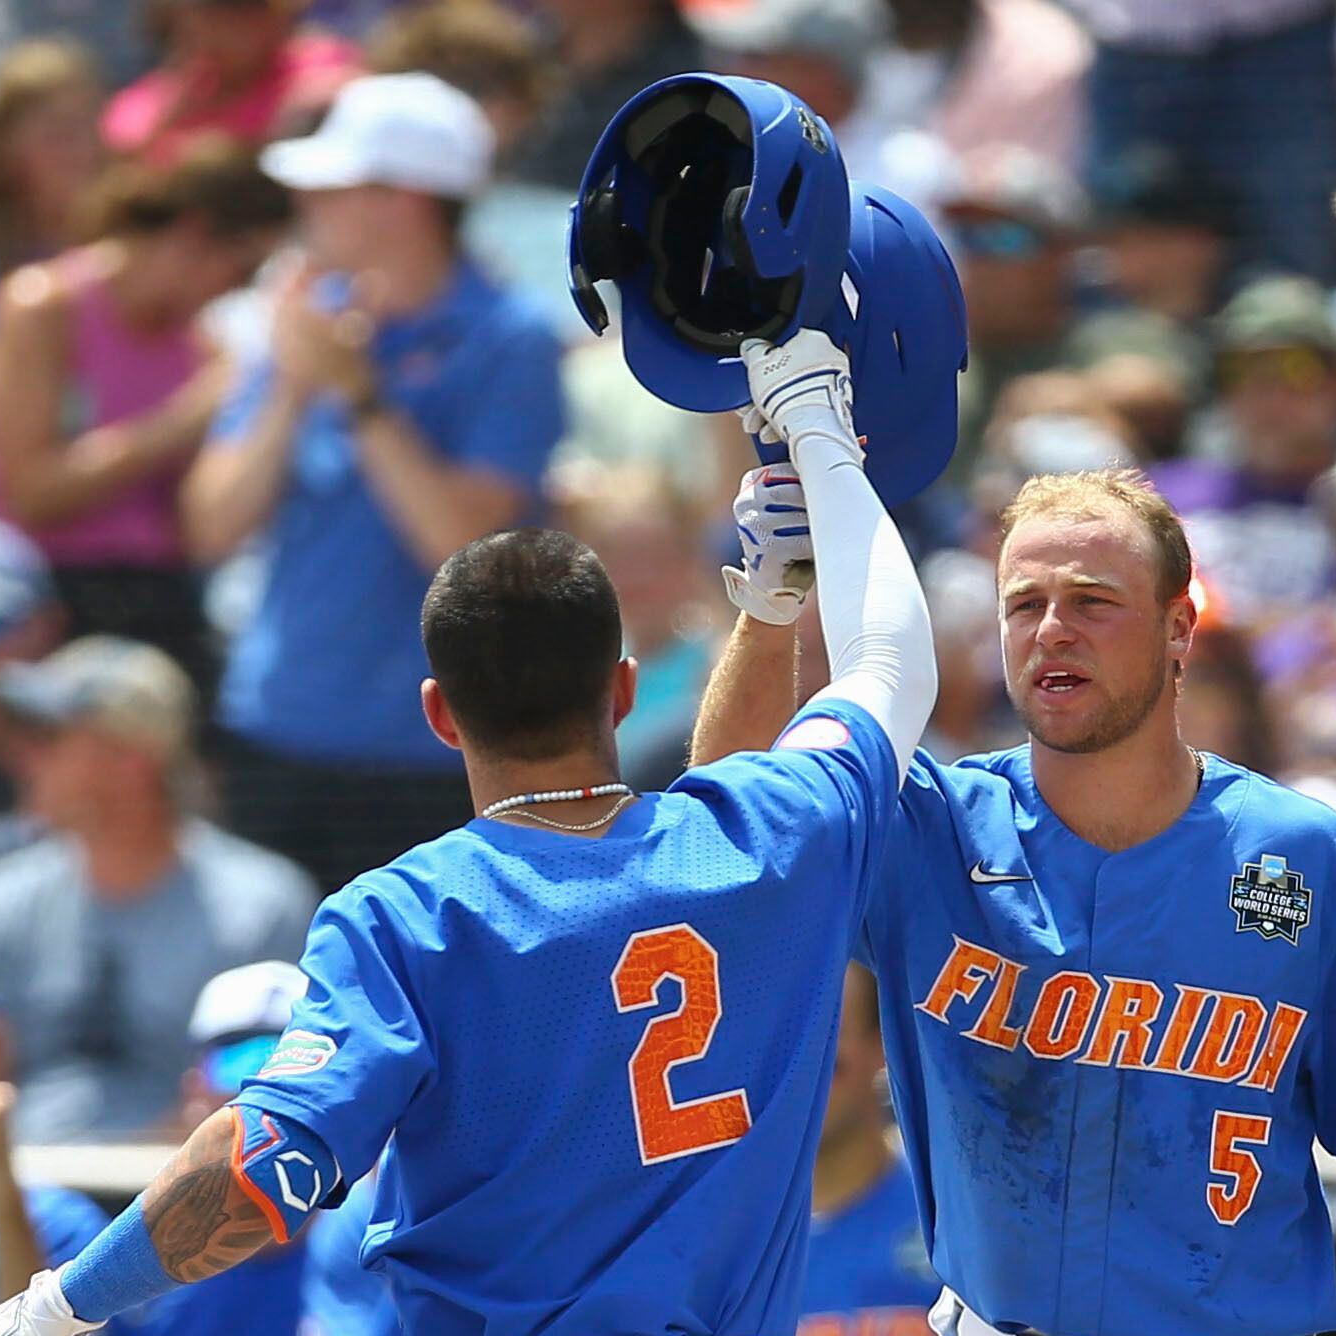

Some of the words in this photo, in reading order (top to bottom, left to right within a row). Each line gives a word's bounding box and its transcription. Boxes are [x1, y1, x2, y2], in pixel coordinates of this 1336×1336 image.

[1233, 897, 1269, 913] WORLD
[1270, 905, 1306, 922] SERIES
[1249, 889, 1293, 907] COLLEGE
[610, 922, 753, 1166] 2
[913, 933, 1308, 1094] FLORIDA
[1206, 1110, 1273, 1225] 5
